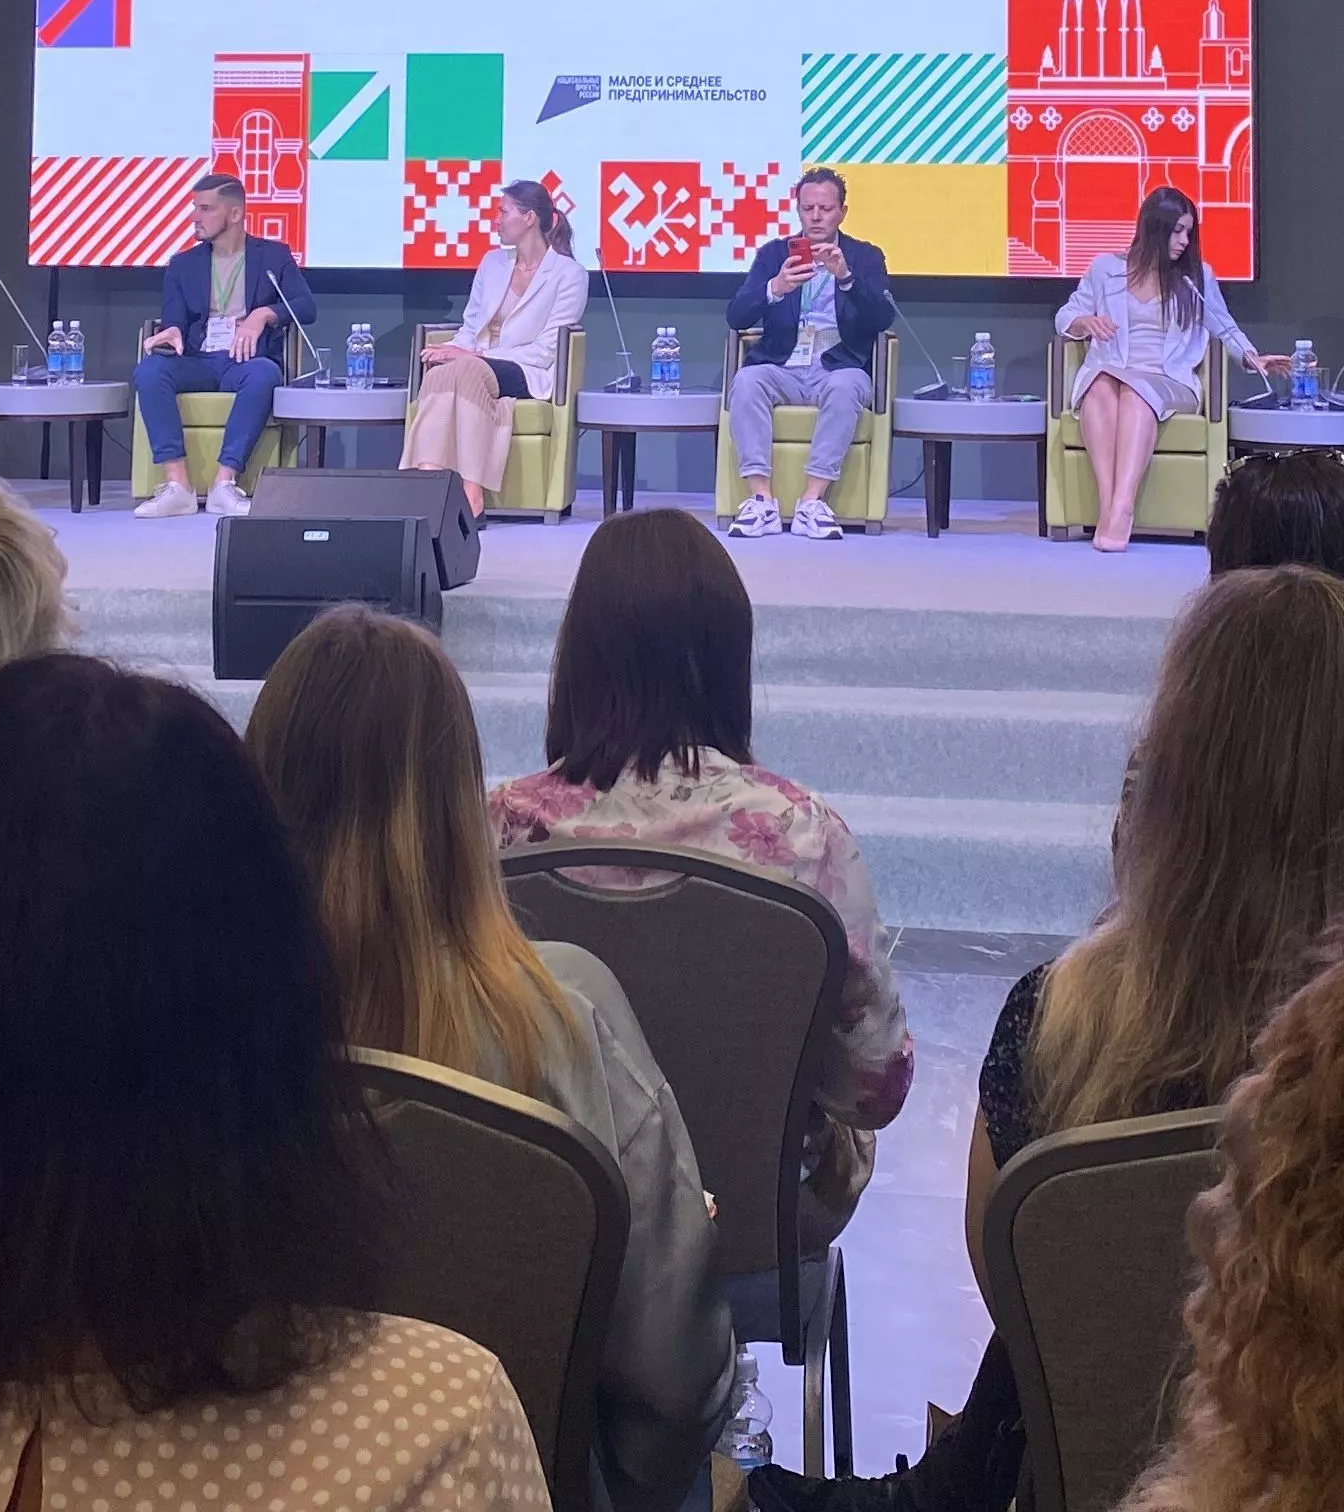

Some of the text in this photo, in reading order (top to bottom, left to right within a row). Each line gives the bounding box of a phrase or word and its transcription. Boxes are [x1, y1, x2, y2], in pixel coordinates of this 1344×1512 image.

[608, 75, 722, 89] МАЛОЕ И СРЕДНЕЕ
[607, 88, 767, 102] ПРЕДПРИНИМАТЕЛЬСТВО
